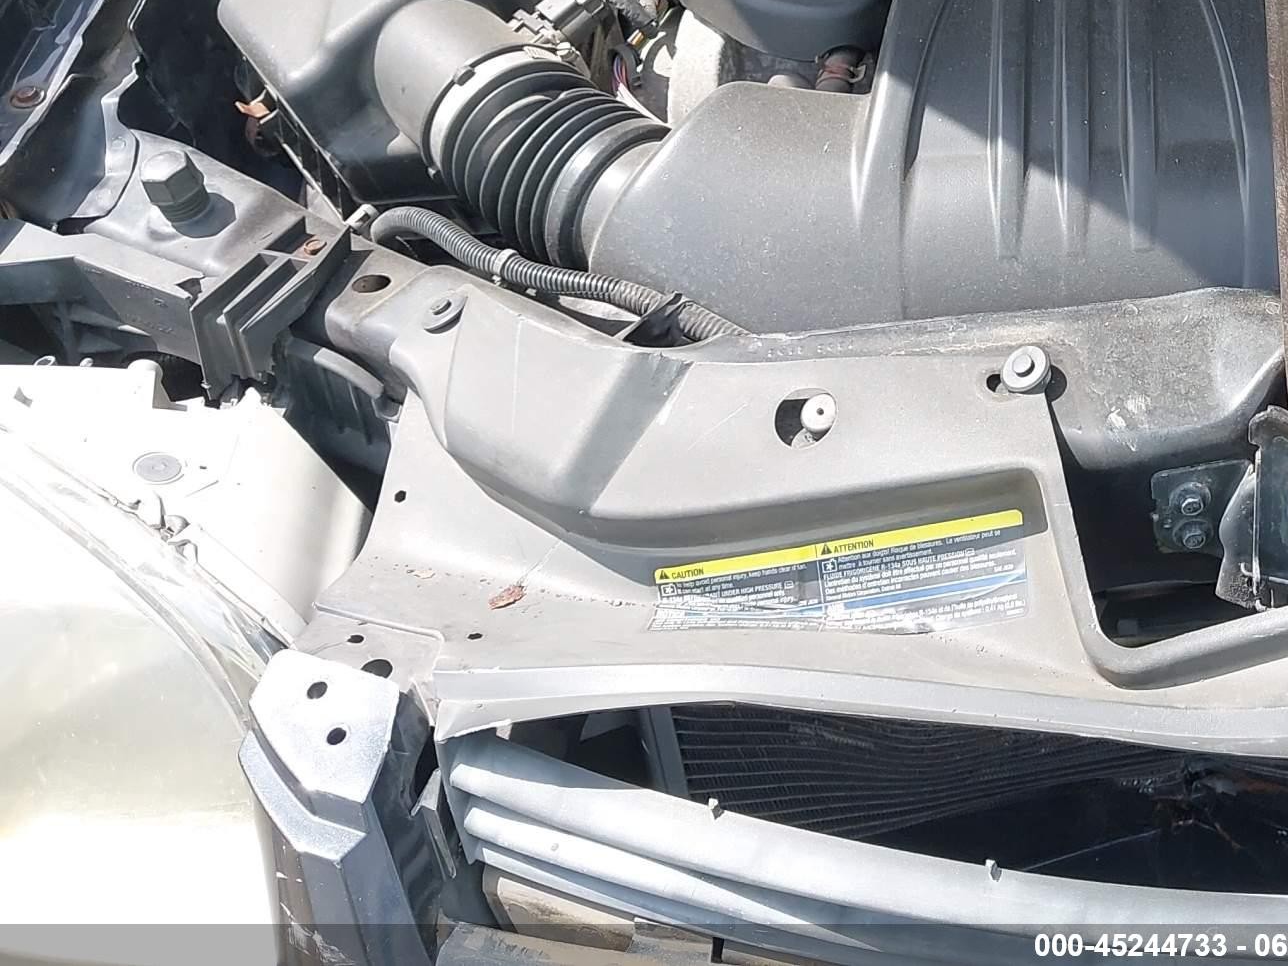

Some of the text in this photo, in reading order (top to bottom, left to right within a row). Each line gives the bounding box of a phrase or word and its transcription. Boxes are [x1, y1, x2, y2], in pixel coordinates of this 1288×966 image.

[834, 539, 873, 553] ATTENTION
[671, 568, 704, 580] CAUTION
[754, 581, 782, 593] PRESSURE
